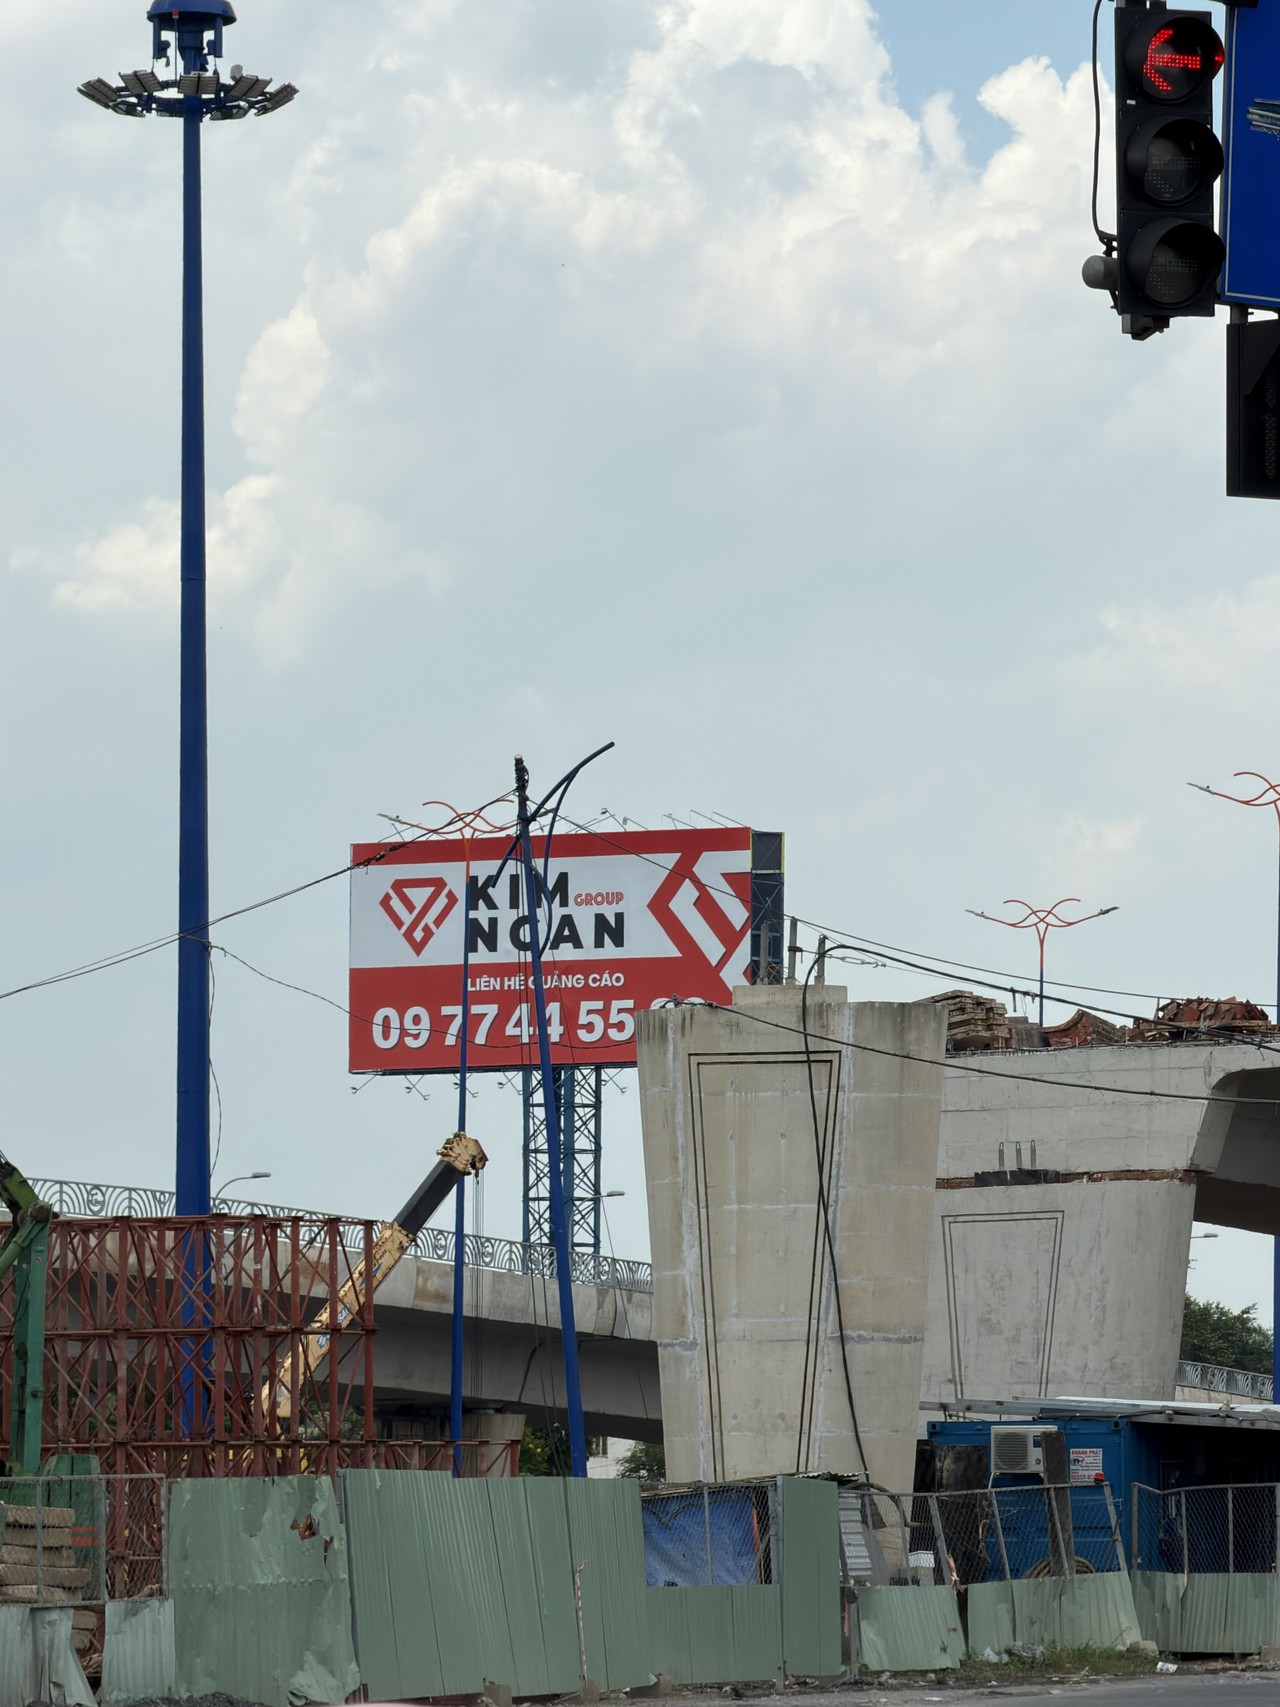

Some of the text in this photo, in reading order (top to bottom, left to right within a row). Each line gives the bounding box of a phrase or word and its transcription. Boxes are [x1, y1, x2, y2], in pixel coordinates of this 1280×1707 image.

[468, 871, 625, 911] KIM GROUP
[467, 974, 501, 992] LIÊN
[588, 969, 625, 988] CÁO
[371, 999, 635, 1049] 09 77 44 55
